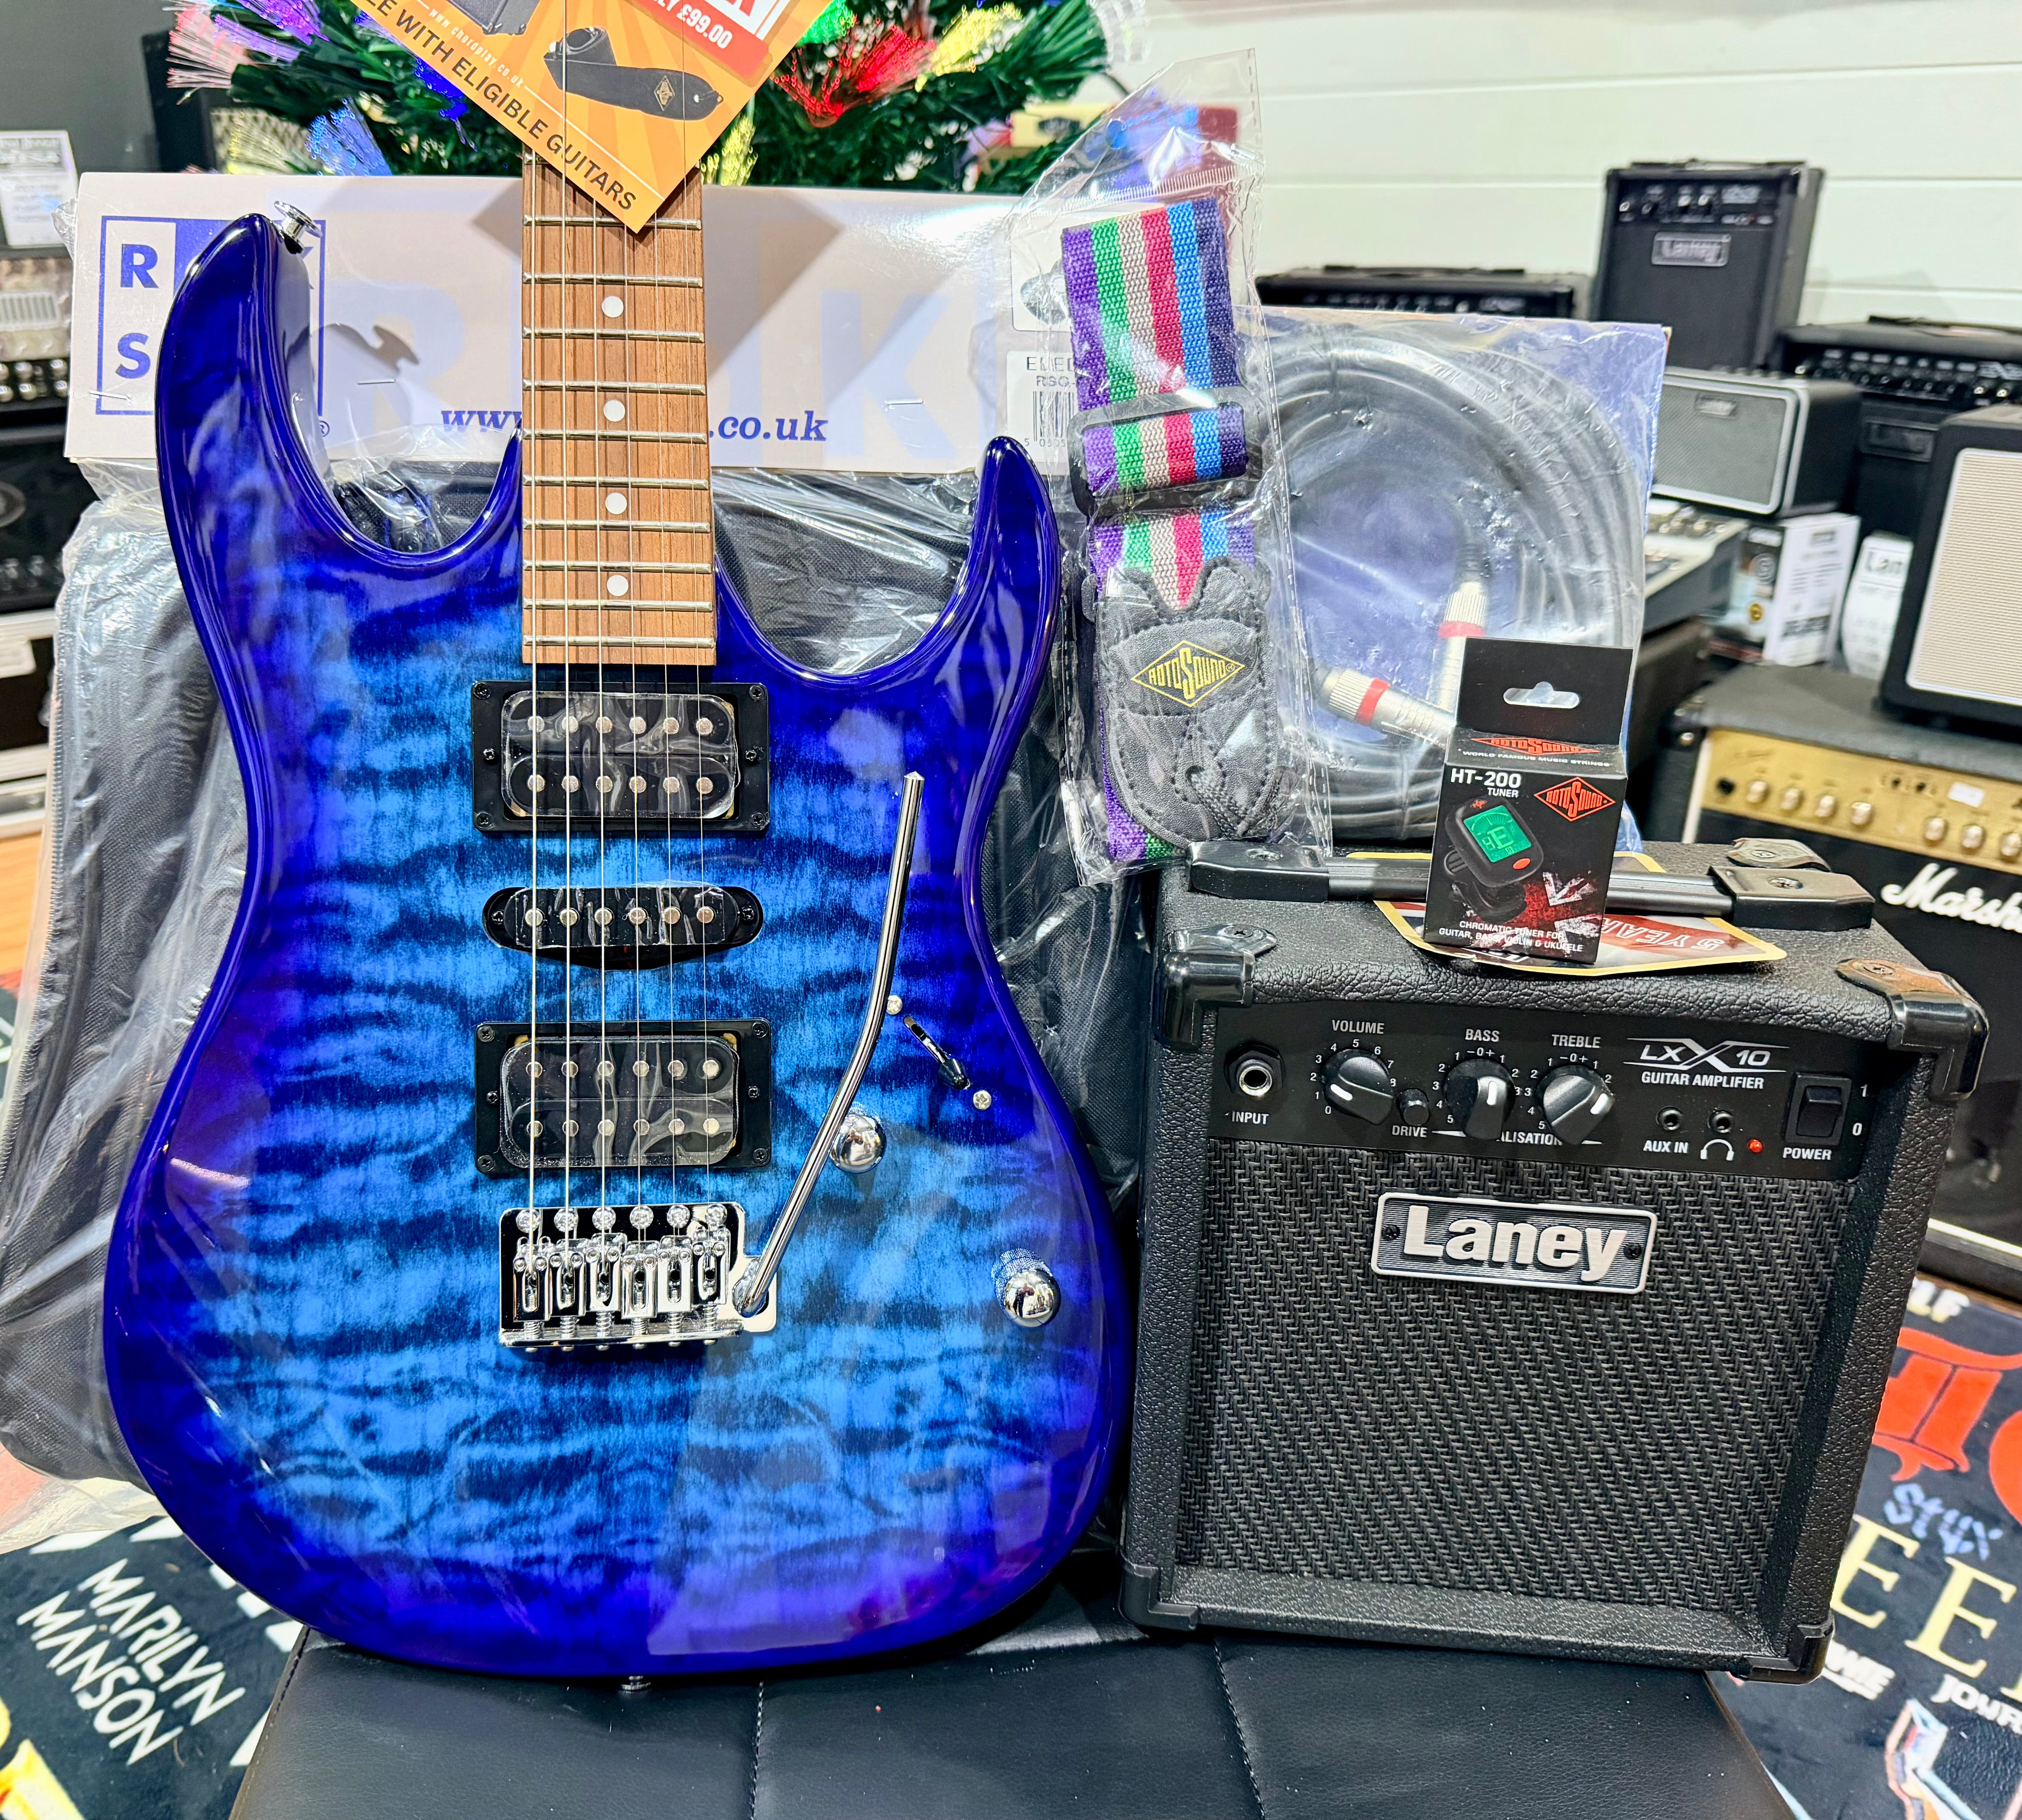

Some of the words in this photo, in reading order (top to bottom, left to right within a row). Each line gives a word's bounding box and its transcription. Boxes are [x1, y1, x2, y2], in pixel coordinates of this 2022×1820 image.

[396, 9, 455, 63] WITH
[452, 57, 548, 139] ELIGIBLE
[547, 134, 636, 210] GUITARS
[1450, 768, 1522, 788] HT-200
[1487, 787, 1519, 798] TUNER
[1459, 921, 1513, 935] CHROMATIC
[1514, 927, 1544, 938] TUNER
[1438, 927, 1473, 940] GUITAR,
[1504, 935, 1533, 947] VIOLIN
[1544, 940, 1584, 952] UKULELE
[1332, 1020, 1385, 1034] VOLUME
[1465, 1029, 1500, 1042] BASS
[1551, 1034, 1601, 1048] TREBLE
[1641, 1071, 1690, 1085] GUITAR
[1692, 1074, 1765, 1089] AMPLIFIER
[1232, 1111, 1269, 1125] INPUT
[1392, 1125, 1428, 1138] DRIVE
[1497, 1131, 1563, 1146] LISATION
[1643, 1140, 1672, 1153] AUX
[1674, 1142, 1689, 1154] IN
[1783, 1147, 1832, 1161] POWER
[1403, 1205, 1628, 1282] Laney
[77, 1558, 246, 1726] MARILYN
[17, 1591, 184, 1766] MANSON
